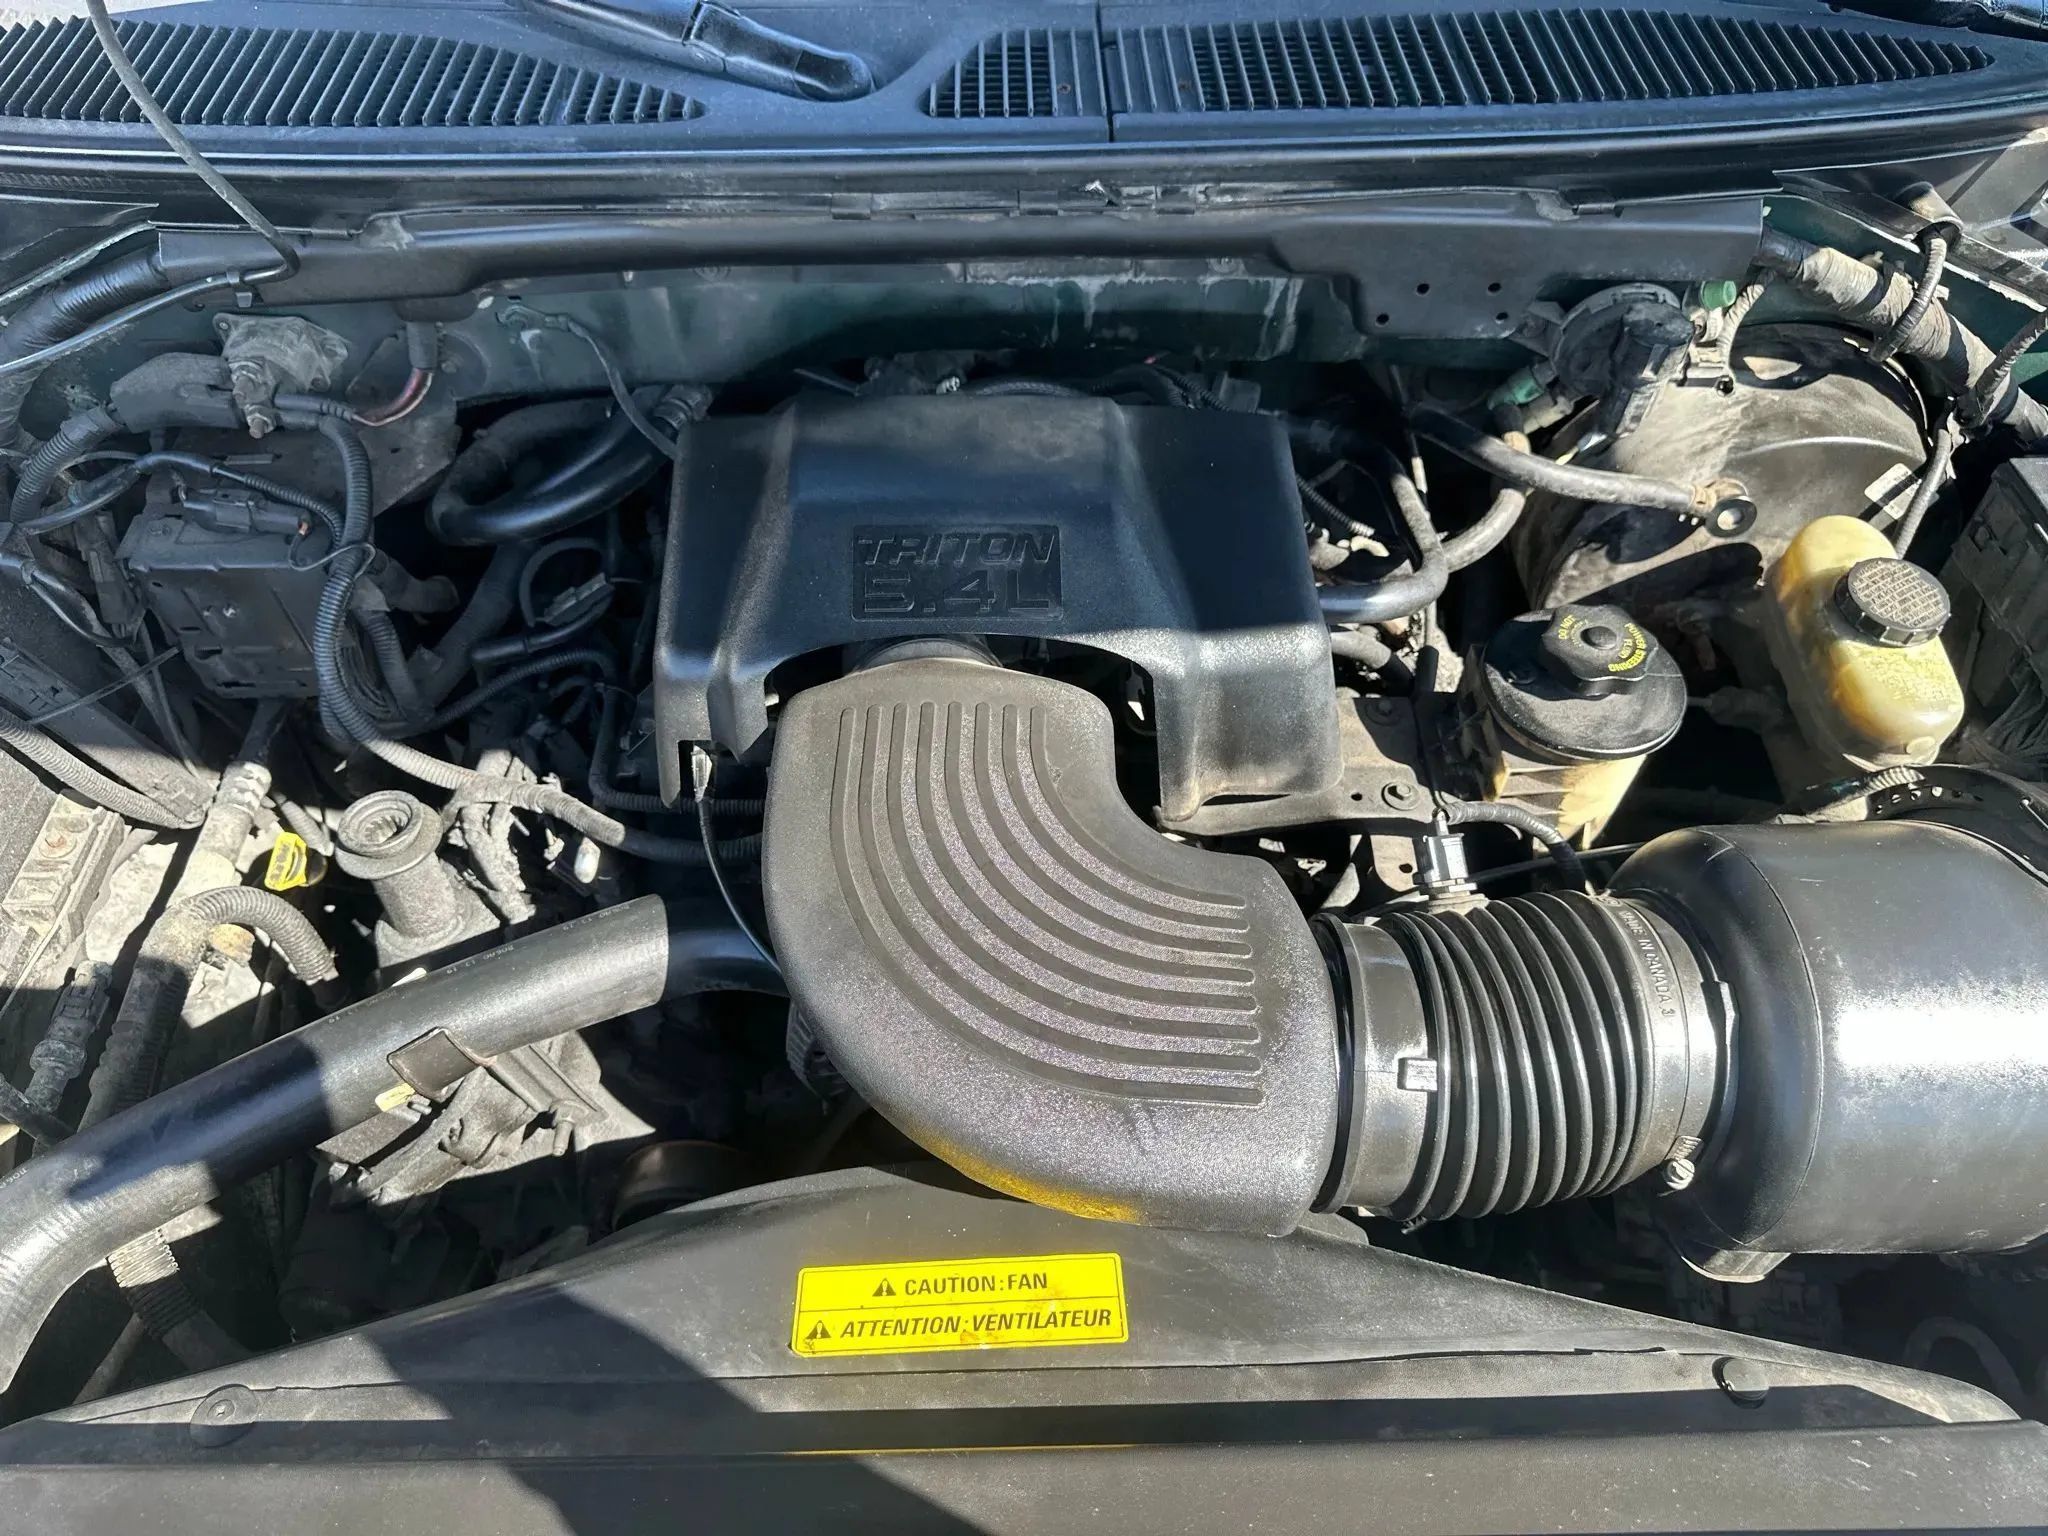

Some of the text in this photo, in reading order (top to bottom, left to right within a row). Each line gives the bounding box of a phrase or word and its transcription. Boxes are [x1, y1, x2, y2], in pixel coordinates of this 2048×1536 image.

[858, 533, 1055, 565] TRITON
[865, 569, 1050, 612] 5.4L
[1608, 622, 1647, 672] POWER STEERING
[1619, 910, 1647, 935] MADE
[1638, 939, 1655, 950] IN
[1645, 953, 1672, 1004] CANADA
